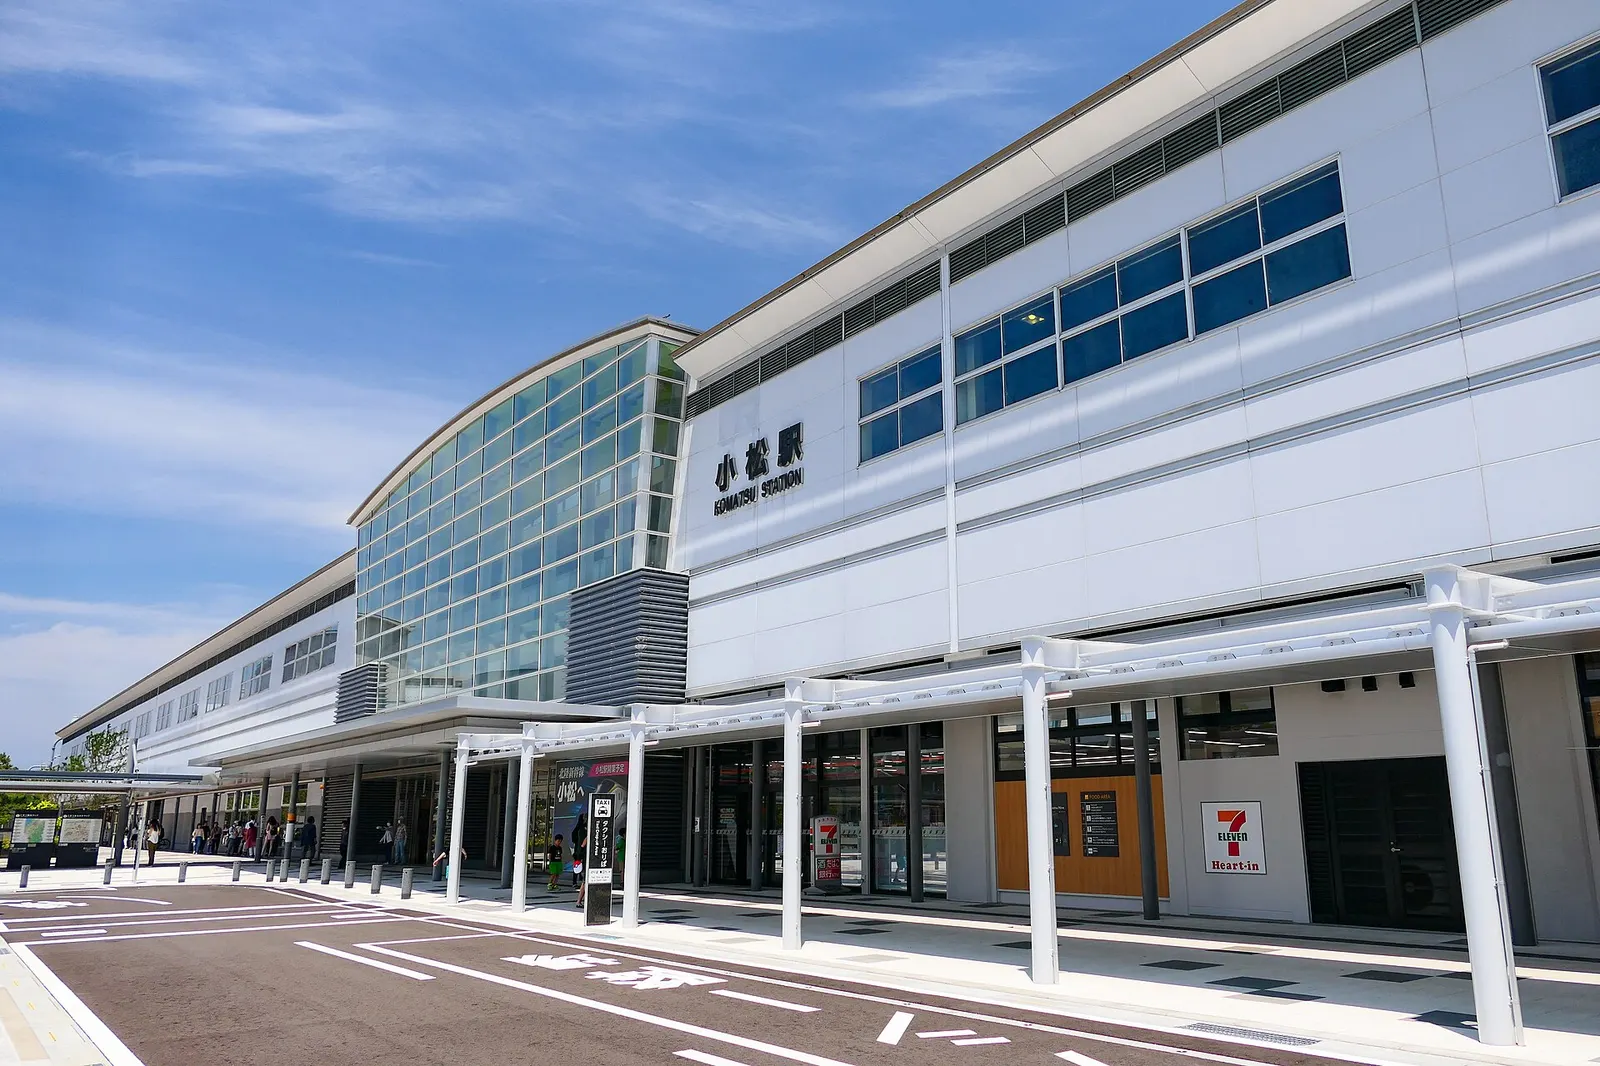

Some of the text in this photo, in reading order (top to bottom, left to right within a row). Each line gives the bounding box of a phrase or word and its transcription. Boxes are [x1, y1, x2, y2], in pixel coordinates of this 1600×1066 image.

[715, 421, 804, 493] 小松駅
[713, 467, 804, 516] KOMATSU STATION
[558, 766, 585, 779] 北陸新幹線
[557, 781, 585, 803] 小松へ
[600, 820, 609, 868] タクシーおりば
[820, 825, 838, 854] 7
[1217, 810, 1247, 857] 7
[826, 859, 840, 868] たばこ
[1211, 860, 1260, 871] Heart-in
